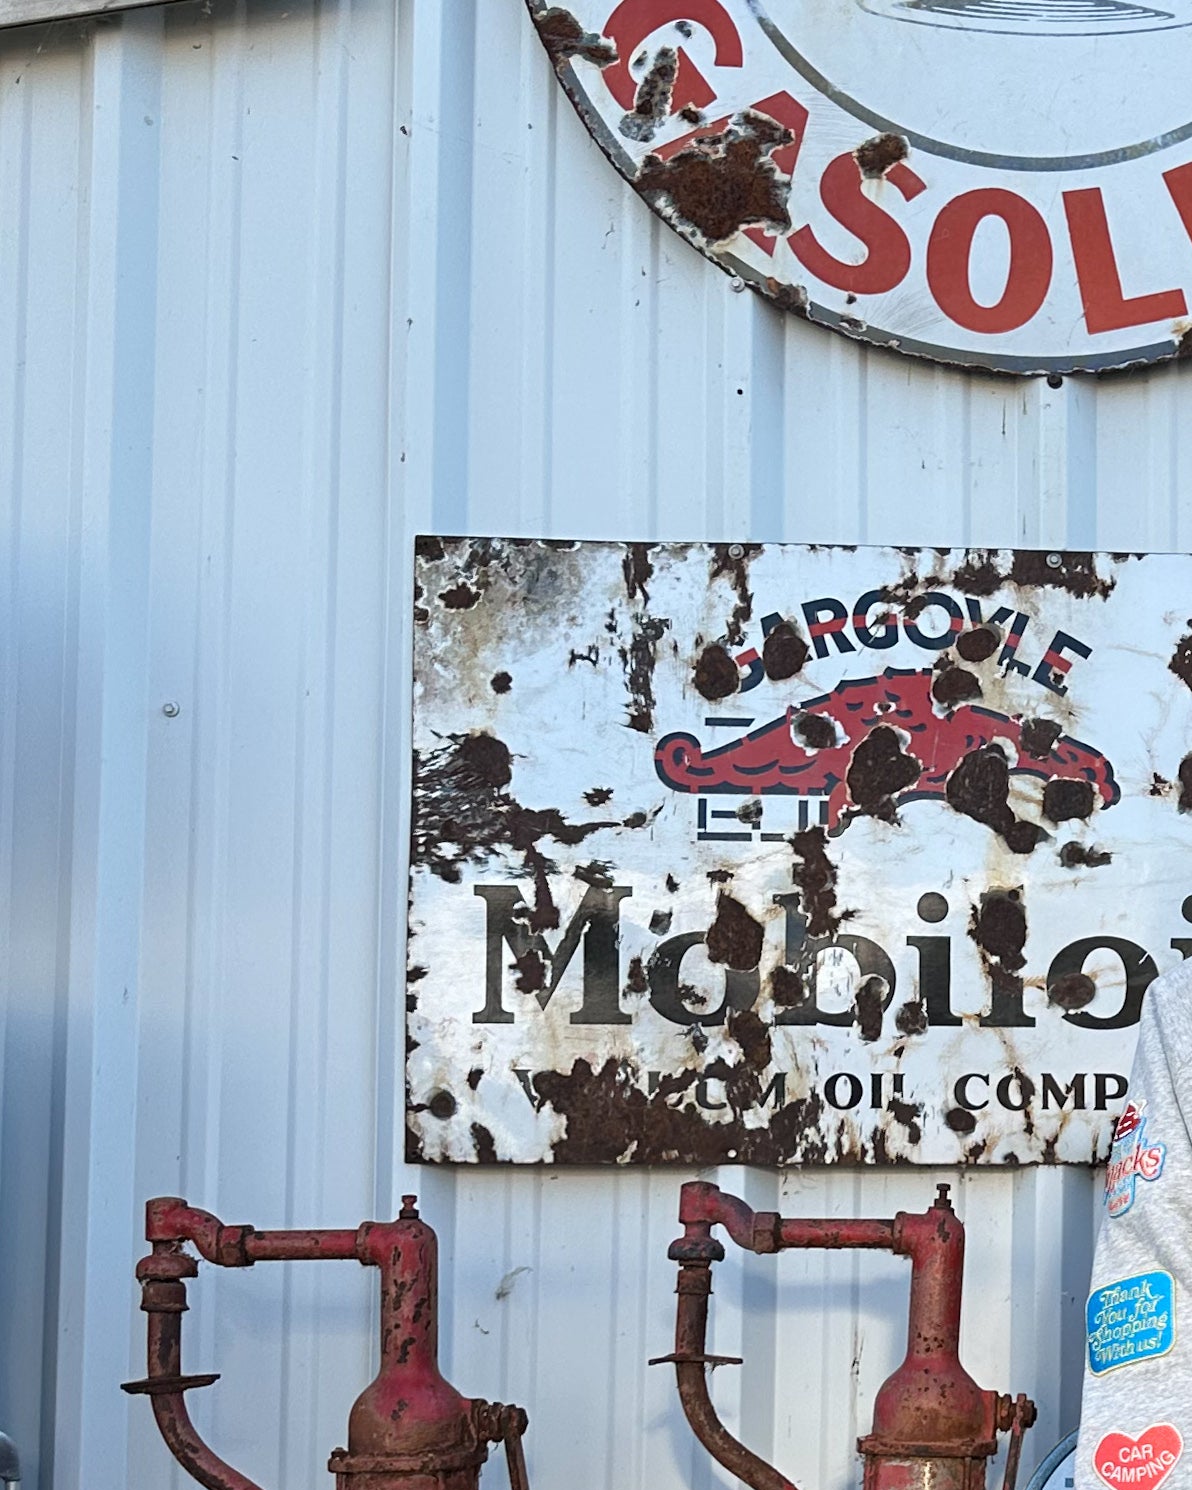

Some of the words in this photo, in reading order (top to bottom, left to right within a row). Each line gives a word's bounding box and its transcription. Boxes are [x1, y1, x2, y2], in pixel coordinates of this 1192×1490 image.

[1100, 1279, 1165, 1309] Thank
[1094, 1307, 1127, 1324] You
[1127, 1297, 1161, 1322] for
[1101, 1450, 1176, 1483] CAMPING
[1118, 1443, 1154, 1464] CAR
